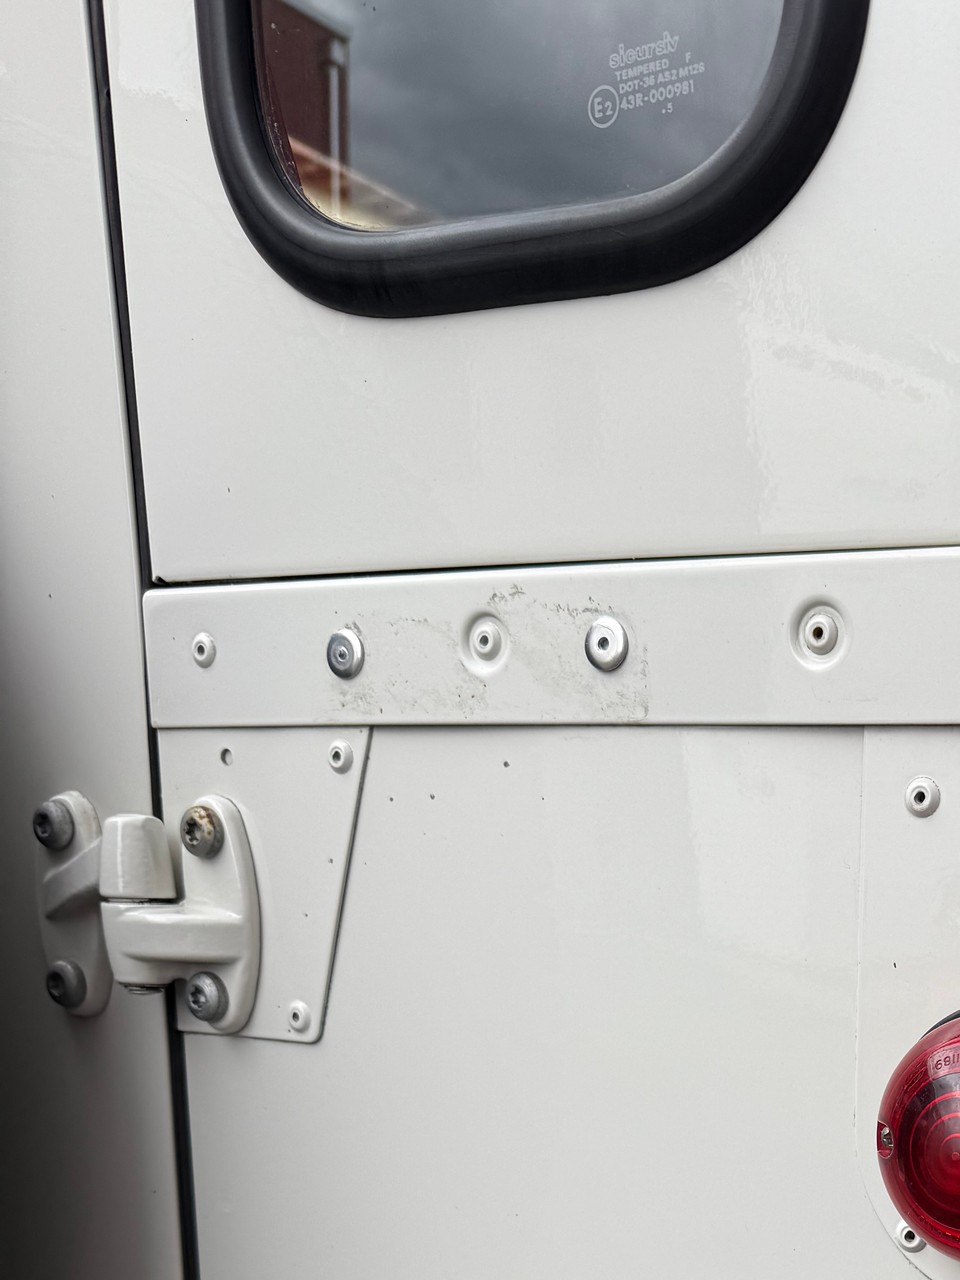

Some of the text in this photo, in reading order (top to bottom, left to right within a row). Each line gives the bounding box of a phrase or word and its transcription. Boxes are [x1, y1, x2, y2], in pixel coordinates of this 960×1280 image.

[608, 31, 680, 69] sicursiv
[614, 52, 692, 81] TEMPERED F
[657, 69, 678, 84] AS2
[620, 79, 694, 110] 43R-000981
